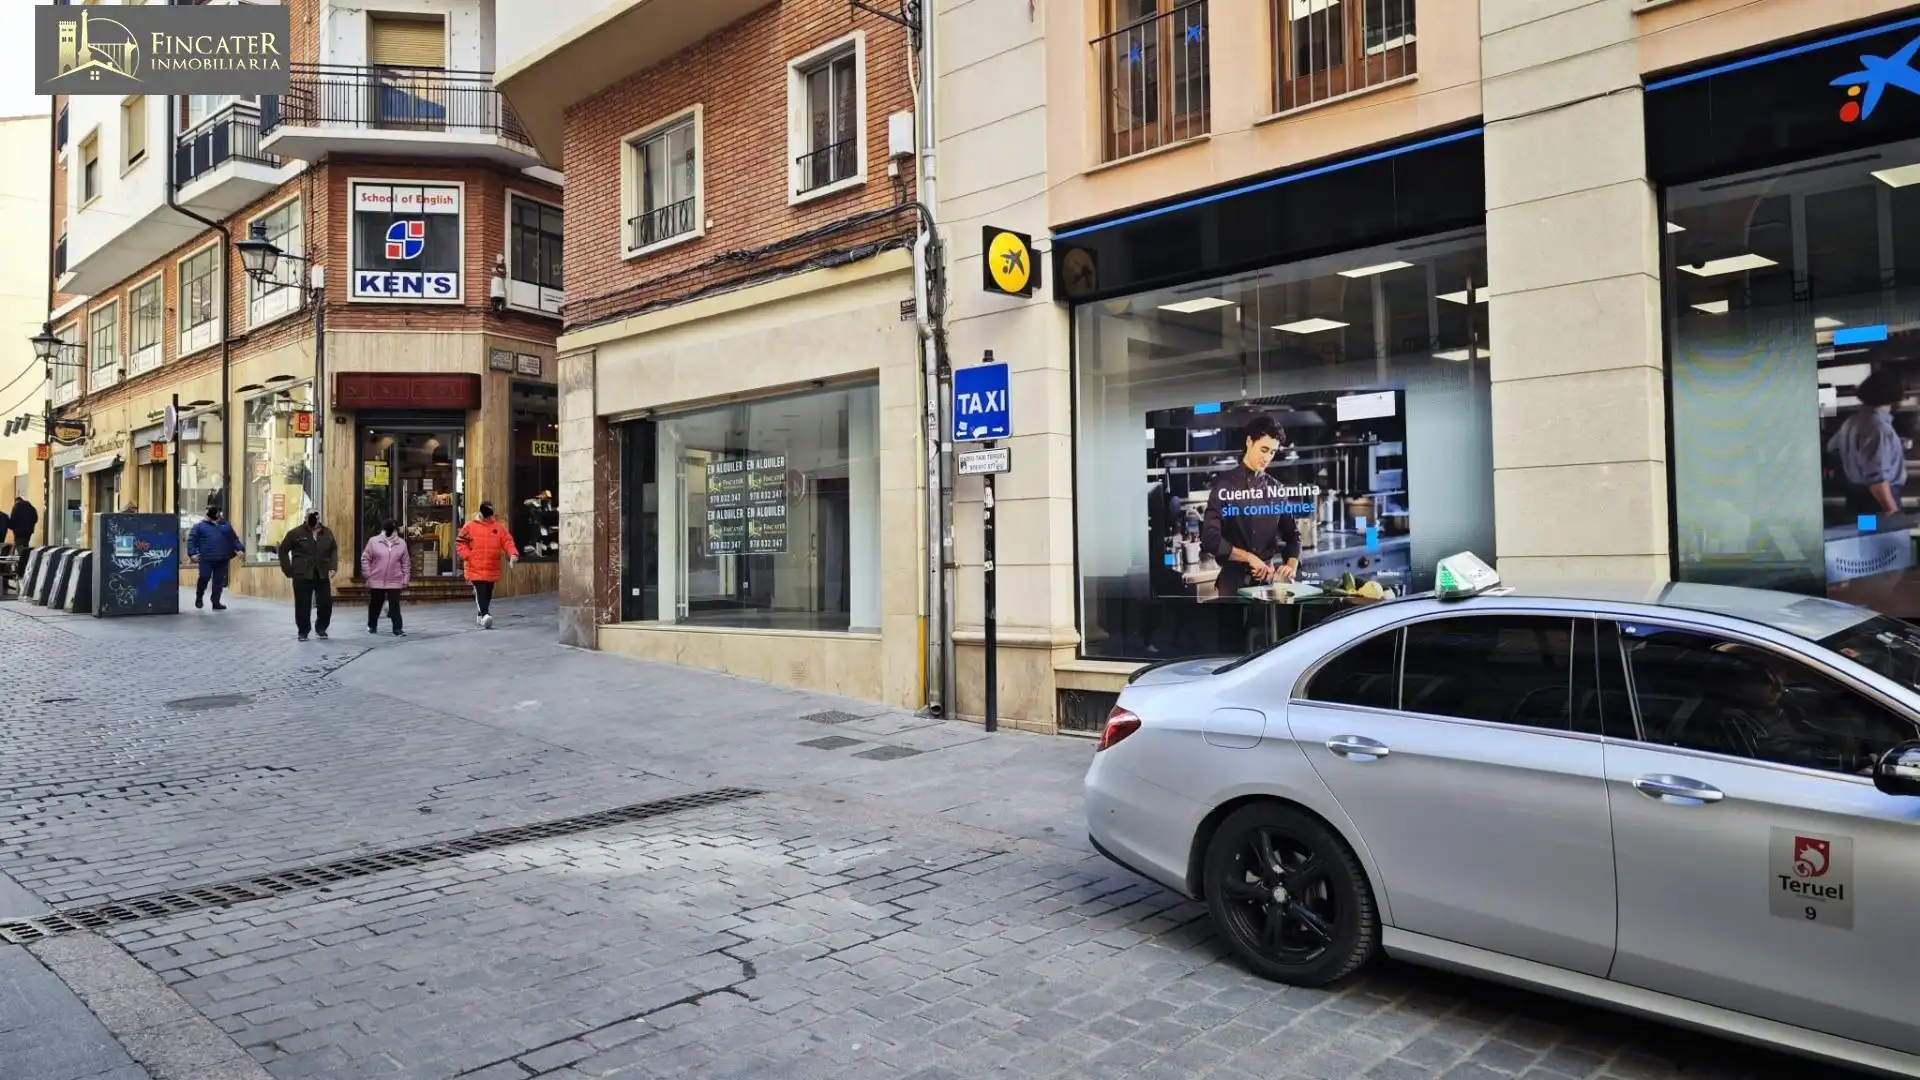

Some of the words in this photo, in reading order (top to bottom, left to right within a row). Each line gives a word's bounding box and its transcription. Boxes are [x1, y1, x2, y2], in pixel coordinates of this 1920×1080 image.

[361, 193, 398, 203] School
[401, 195, 413, 203] of
[416, 195, 453, 205] English
[360, 275, 452, 294] KEN'S
[957, 389, 1006, 415] TAXI
[707, 464, 715, 474] EN
[716, 461, 743, 473] ALQUILER
[746, 460, 754, 471] EN
[756, 456, 784, 469] ALQUILER
[1218, 488, 1263, 500] Cuenta
[1267, 484, 1320, 498] Nómina
[707, 510, 715, 520] EN
[716, 508, 743, 520] ALQUILER
[747, 507, 755, 518] EN
[756, 505, 785, 517] ALQUILER
[1222, 504, 1239, 516] sin
[1243, 502, 1316, 515] comisiones
[1778, 874, 1844, 900] Teruel
[1805, 906, 1817, 920] 9
